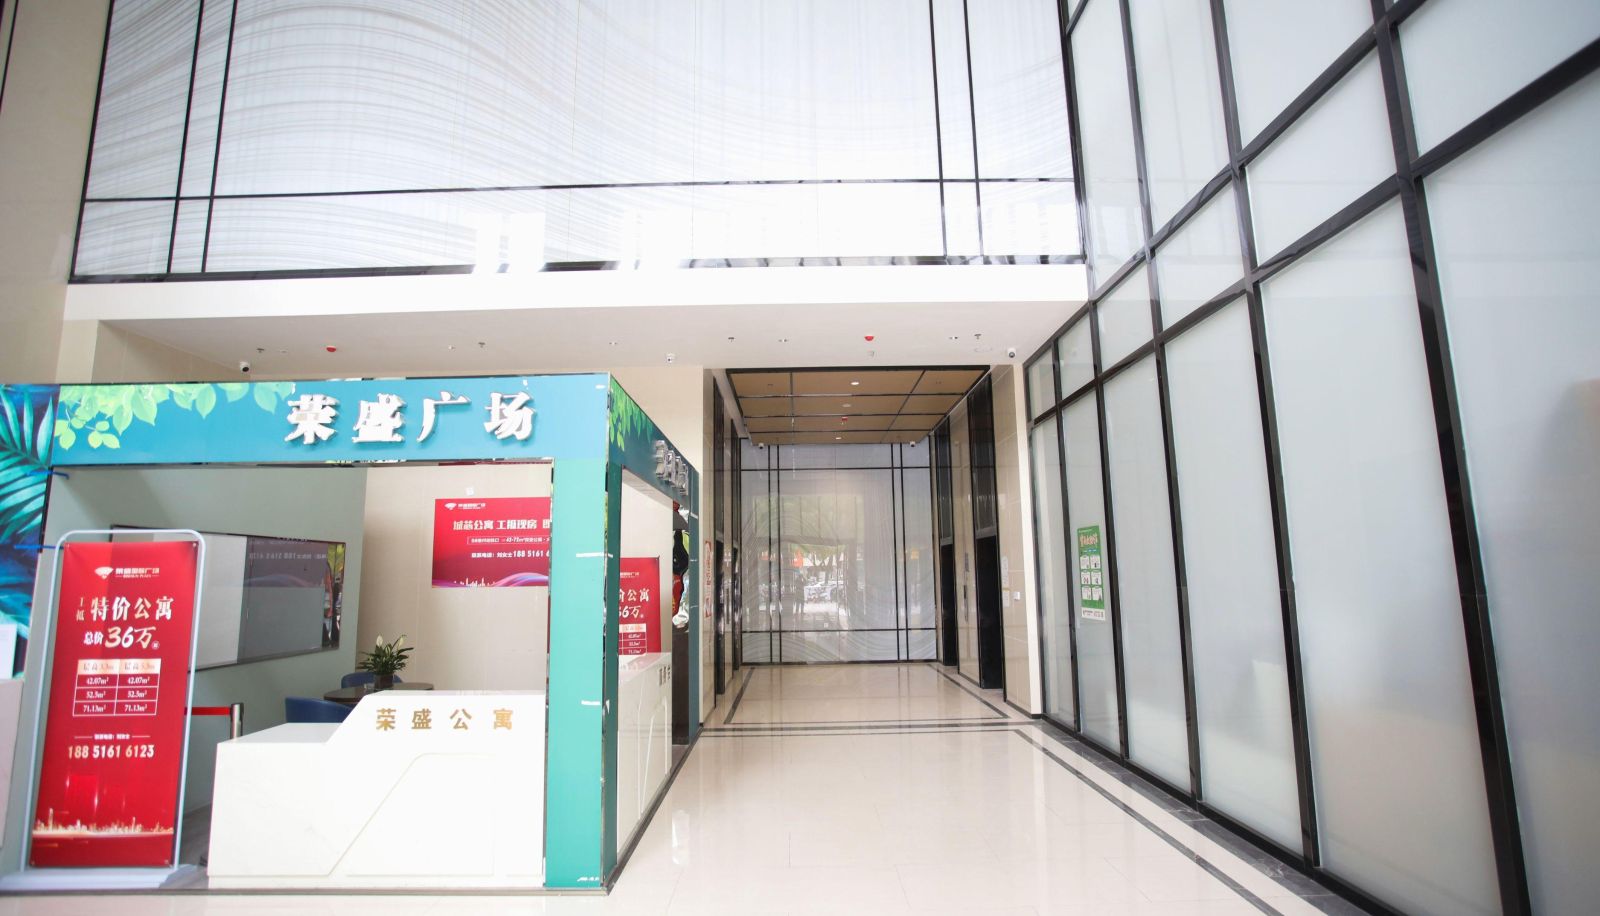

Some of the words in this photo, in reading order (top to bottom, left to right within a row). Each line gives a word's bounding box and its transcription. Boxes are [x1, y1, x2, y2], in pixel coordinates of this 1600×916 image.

[284, 391, 537, 444] 荣盛广场
[527, 550, 544, 558] 5161
[91, 595, 174, 621] 特价公寓
[376, 708, 514, 731] 荣盛公寓
[68, 745, 89, 759] 188
[93, 745, 120, 758] 5161
[125, 745, 155, 758] 6123
